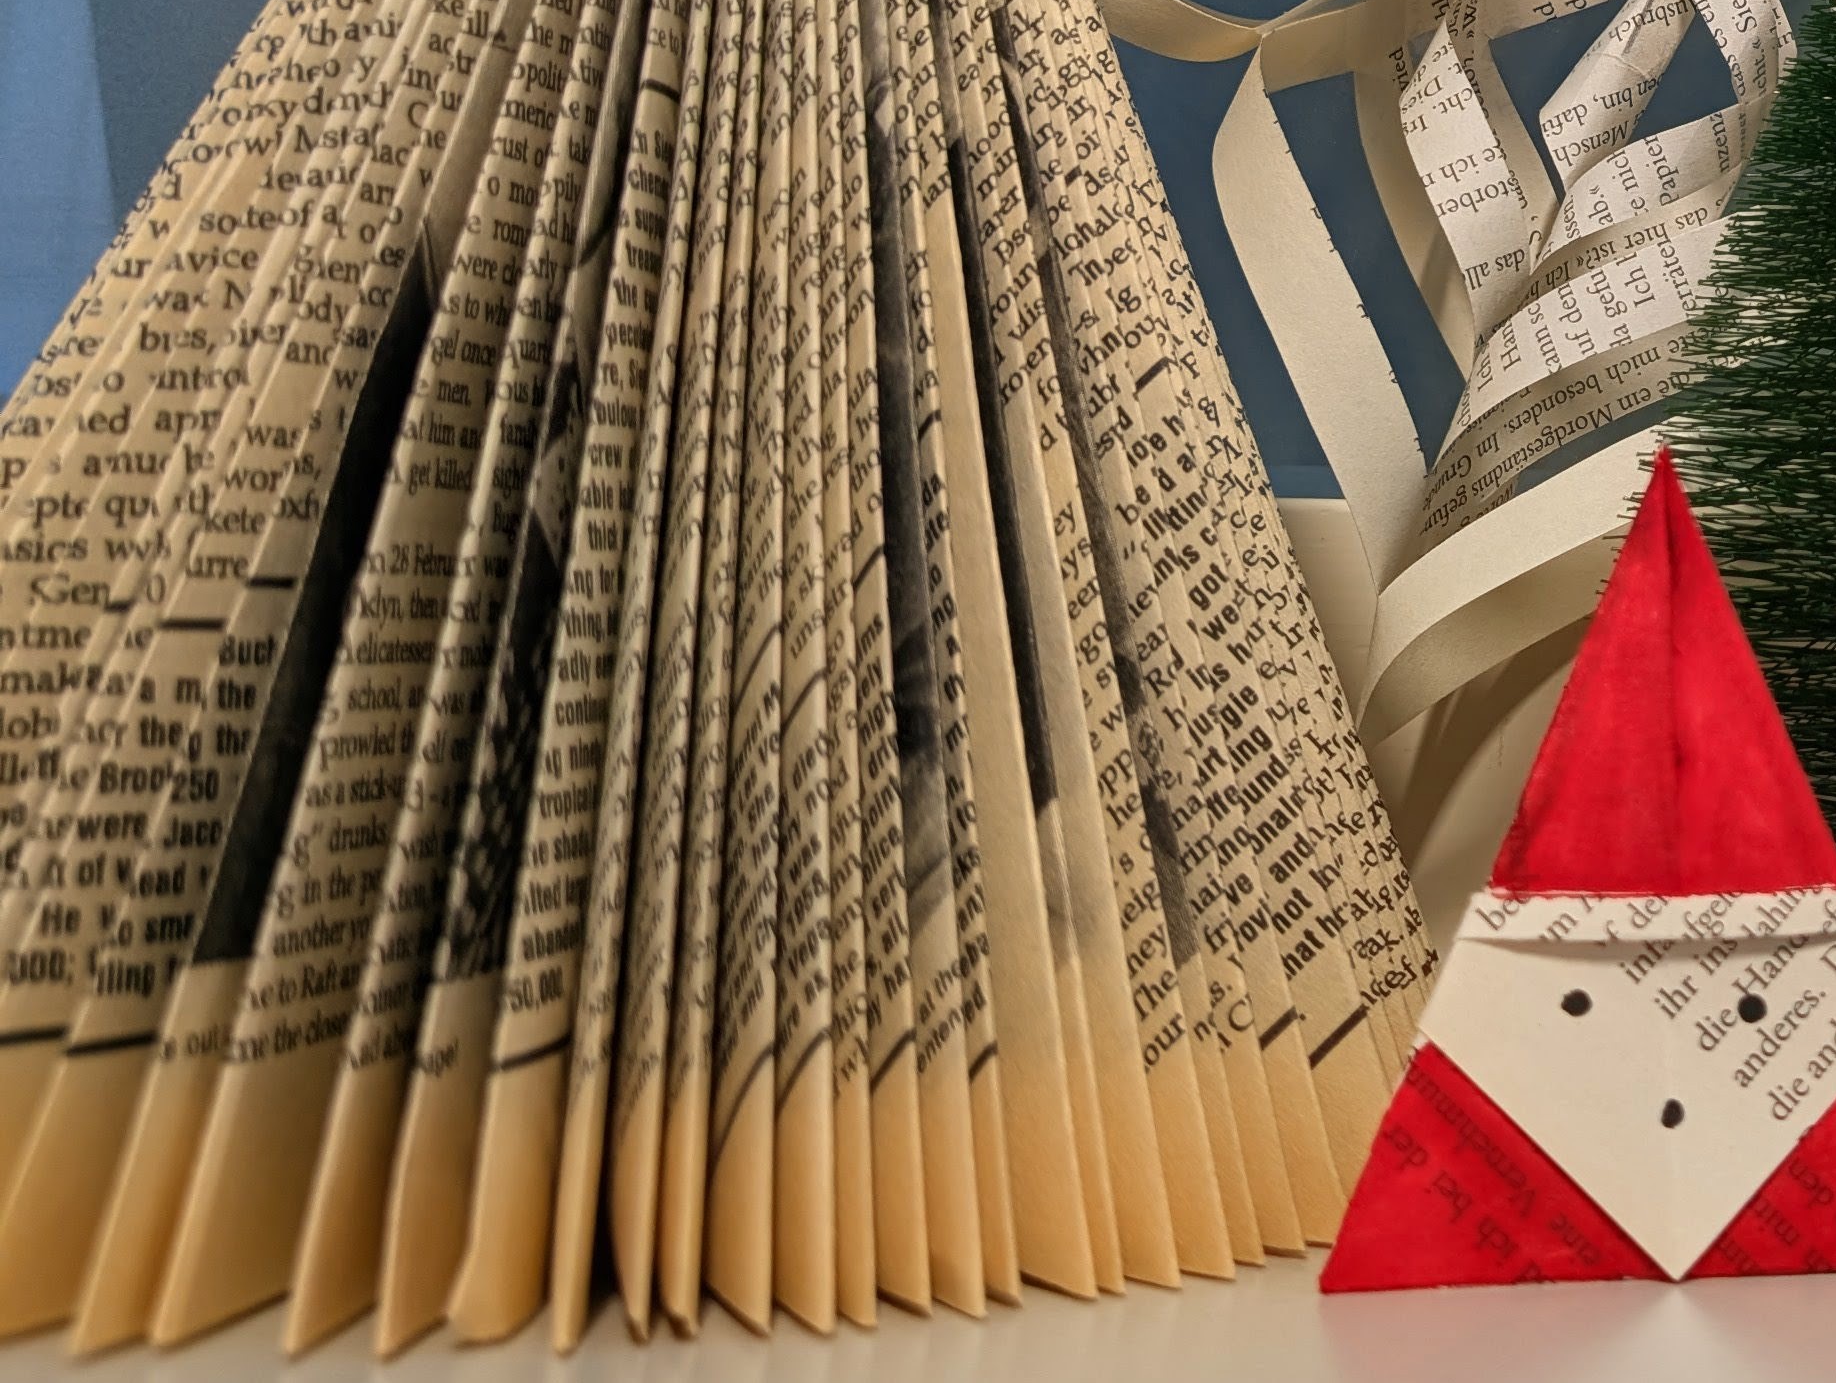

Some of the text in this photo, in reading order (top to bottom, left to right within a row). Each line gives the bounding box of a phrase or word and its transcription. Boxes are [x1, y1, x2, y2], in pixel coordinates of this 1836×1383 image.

[1553, 120, 1628, 180] Mensch
[1643, 133, 1680, 206] Papier
[1496, 249, 1525, 272] das
[1502, 350, 1660, 434] besonders. mich
[1472, 385, 1651, 496] Mordgeständnis ein
[1654, 973, 1699, 1019] ihr
[1699, 1008, 1737, 1054] die
[1732, 988, 1828, 1091] anderes.
[1771, 1076, 1810, 1122] die
